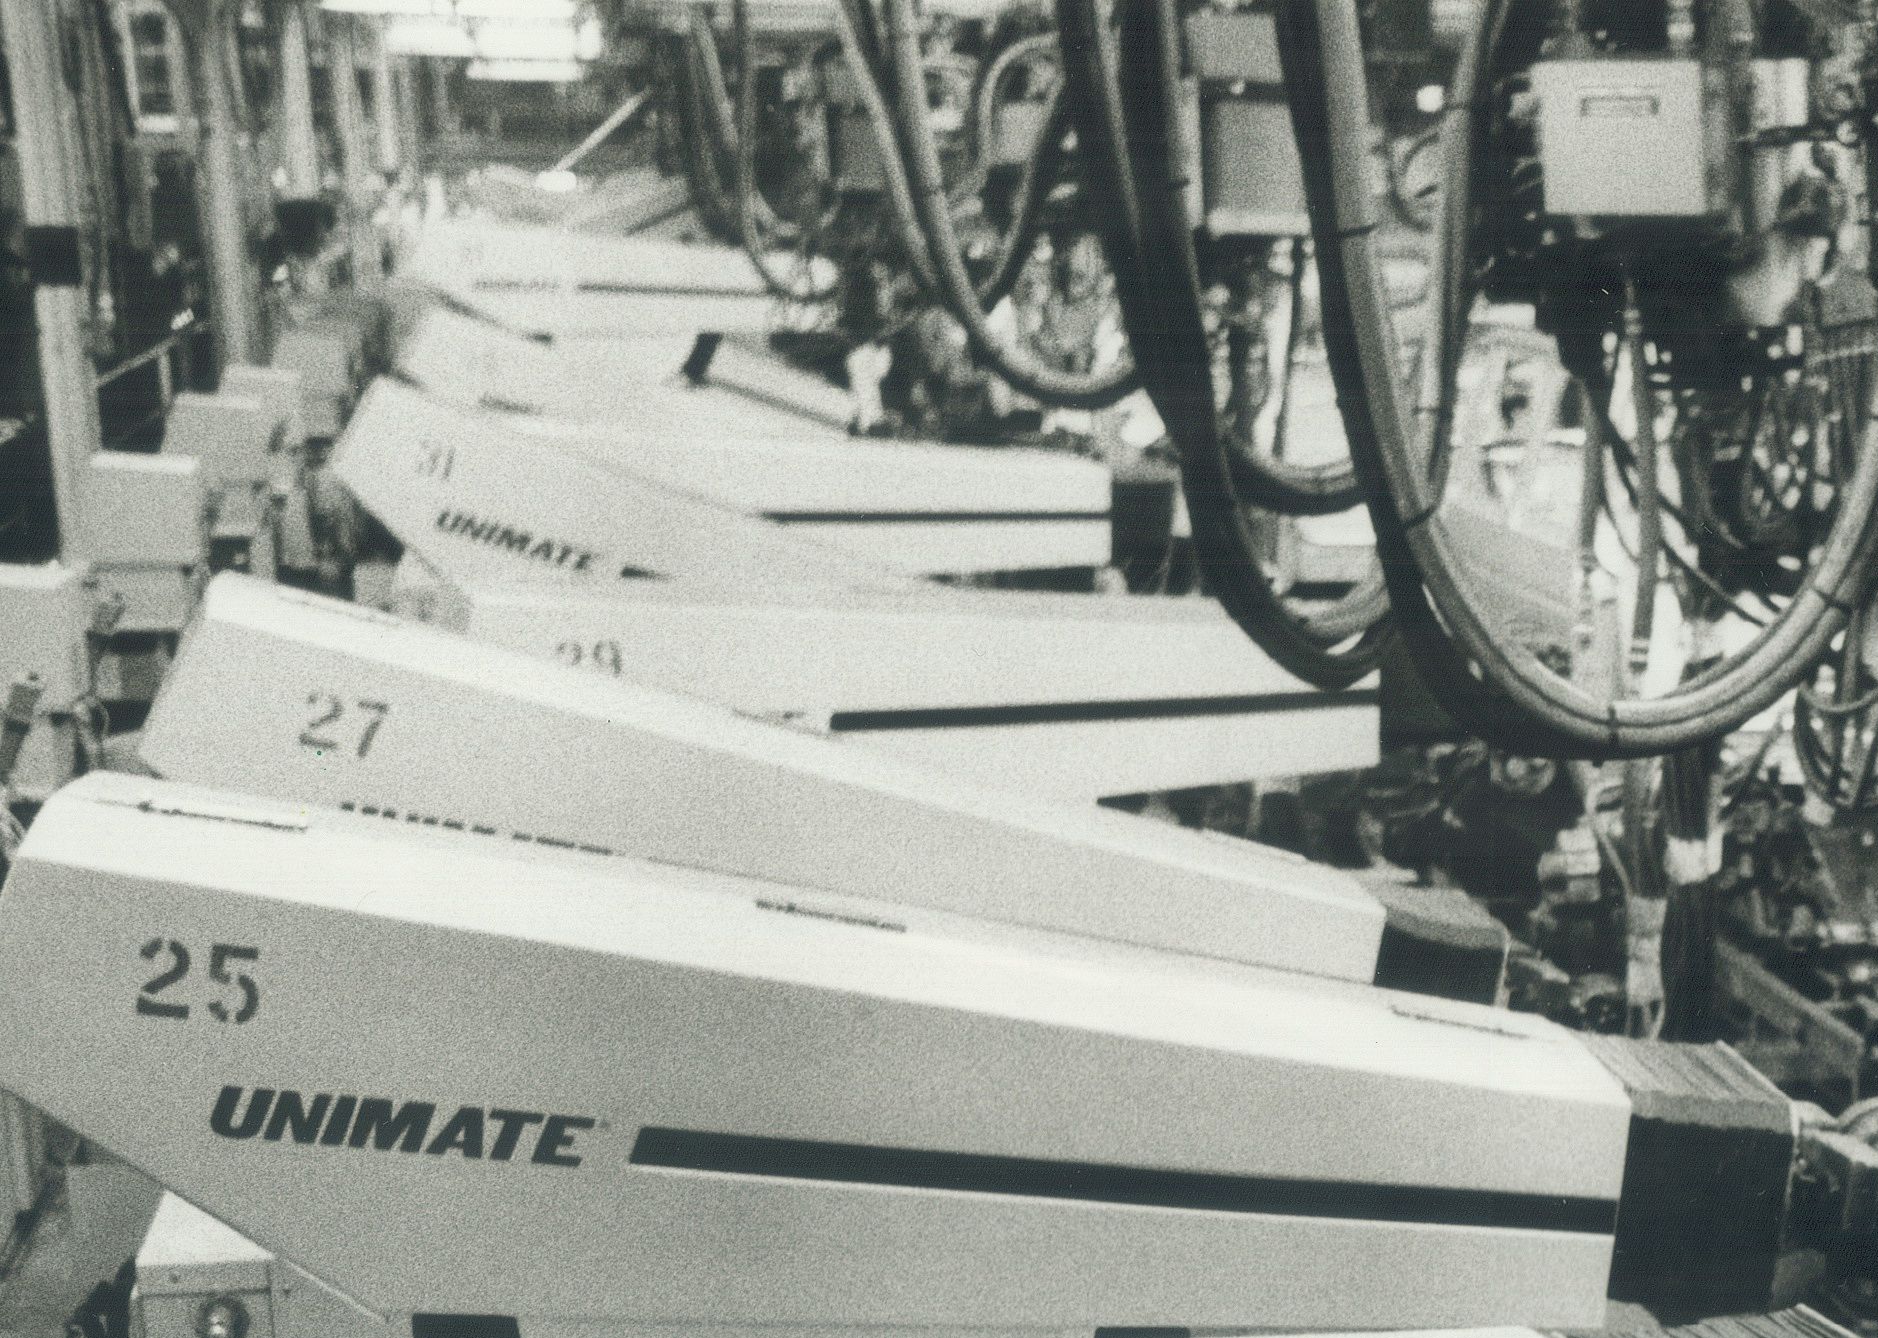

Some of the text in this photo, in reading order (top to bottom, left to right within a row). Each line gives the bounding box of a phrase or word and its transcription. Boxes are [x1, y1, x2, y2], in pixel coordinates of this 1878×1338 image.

[435, 510, 592, 574] UNIMATE
[298, 691, 389, 757] 27
[136, 938, 260, 1025] 25
[210, 1085, 596, 1167] UNIMATE
